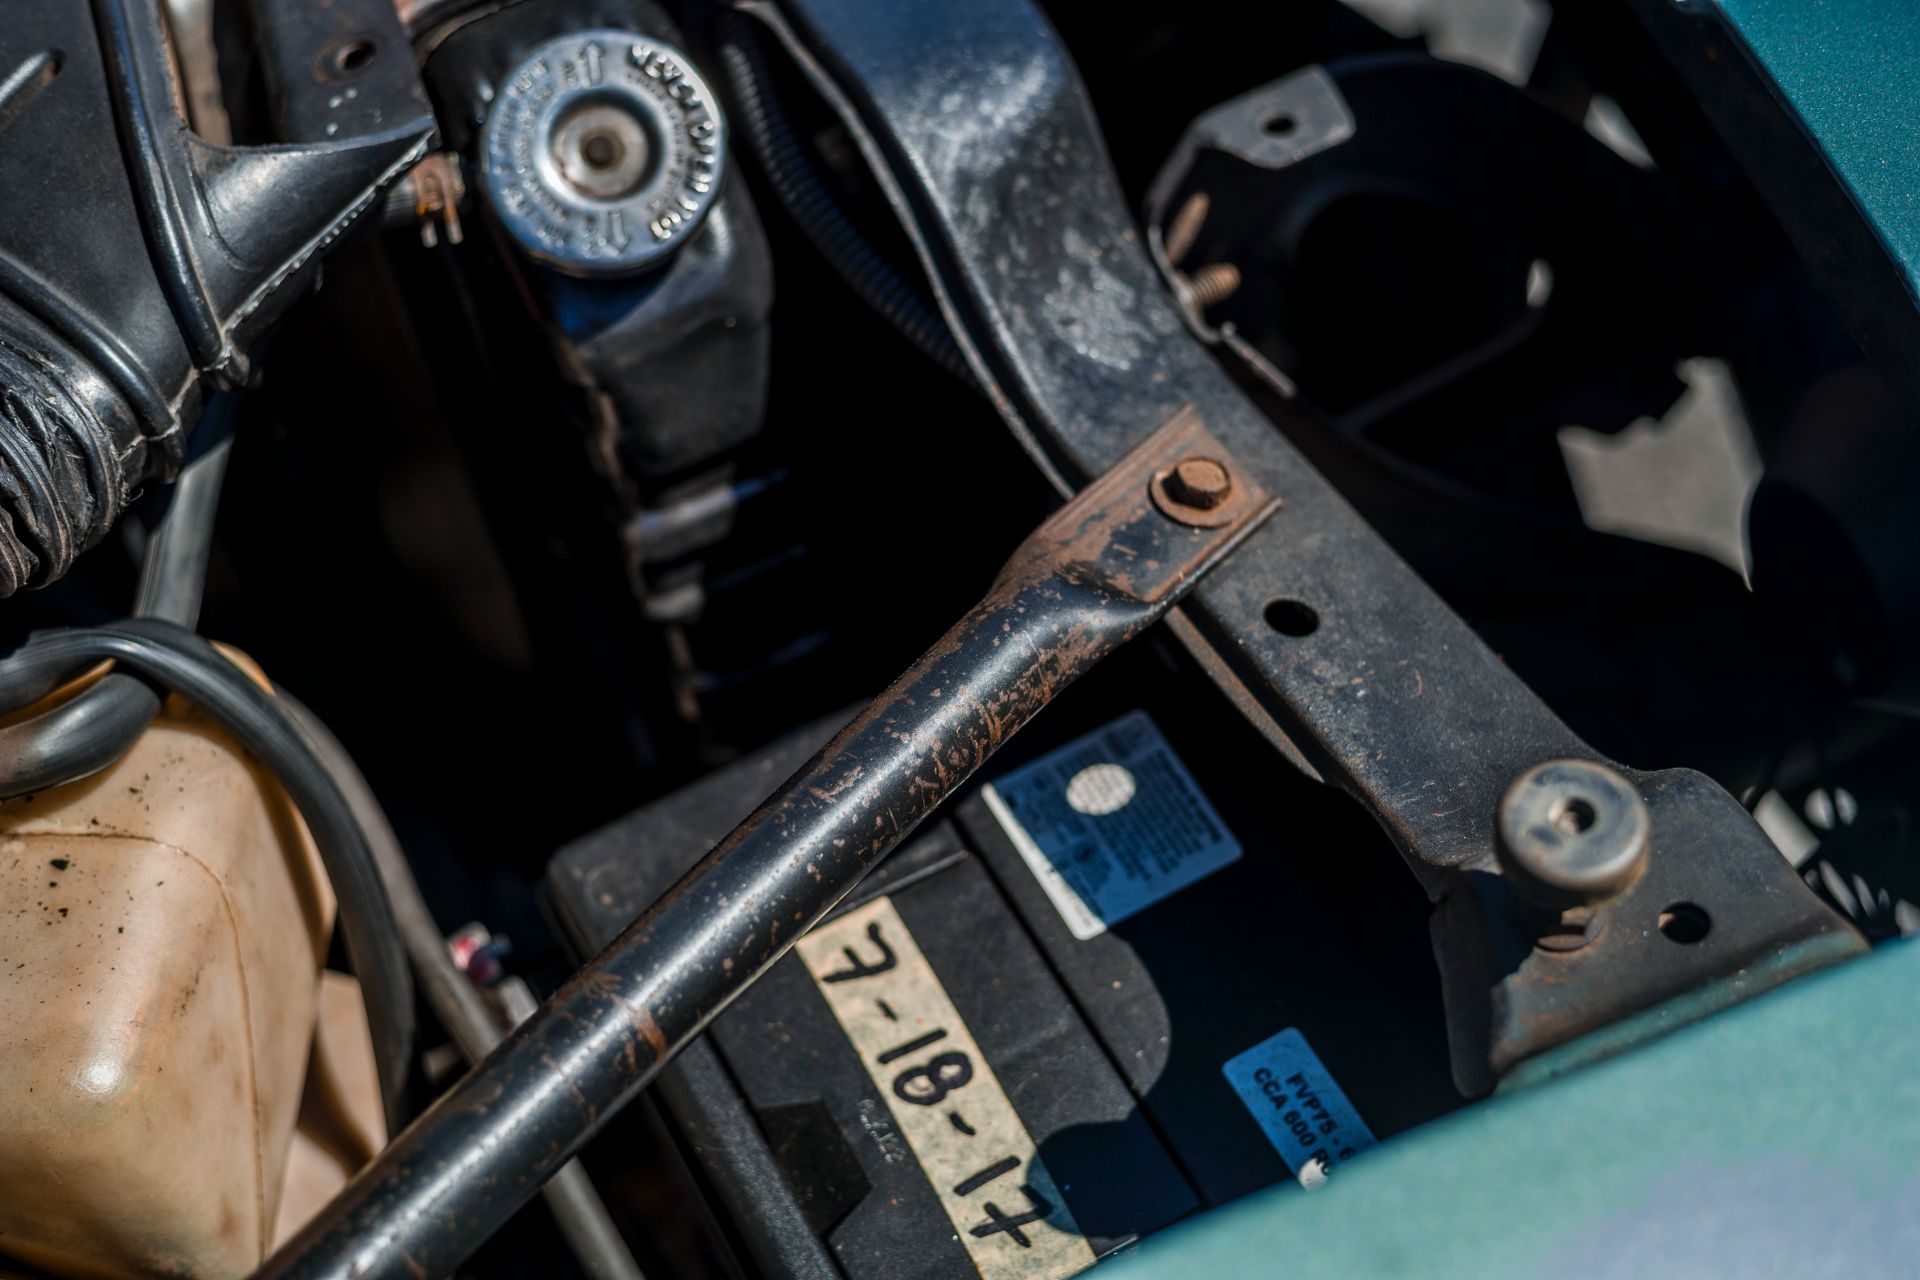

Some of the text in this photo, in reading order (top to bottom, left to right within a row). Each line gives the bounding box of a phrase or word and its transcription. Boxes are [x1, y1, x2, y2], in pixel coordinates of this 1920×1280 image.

[822, 921, 1053, 1248] 7-18-17
[1253, 1067, 1288, 1110] CCA
[1283, 1110, 1317, 1147] 600
[1286, 1072, 1338, 1135] FVP75
